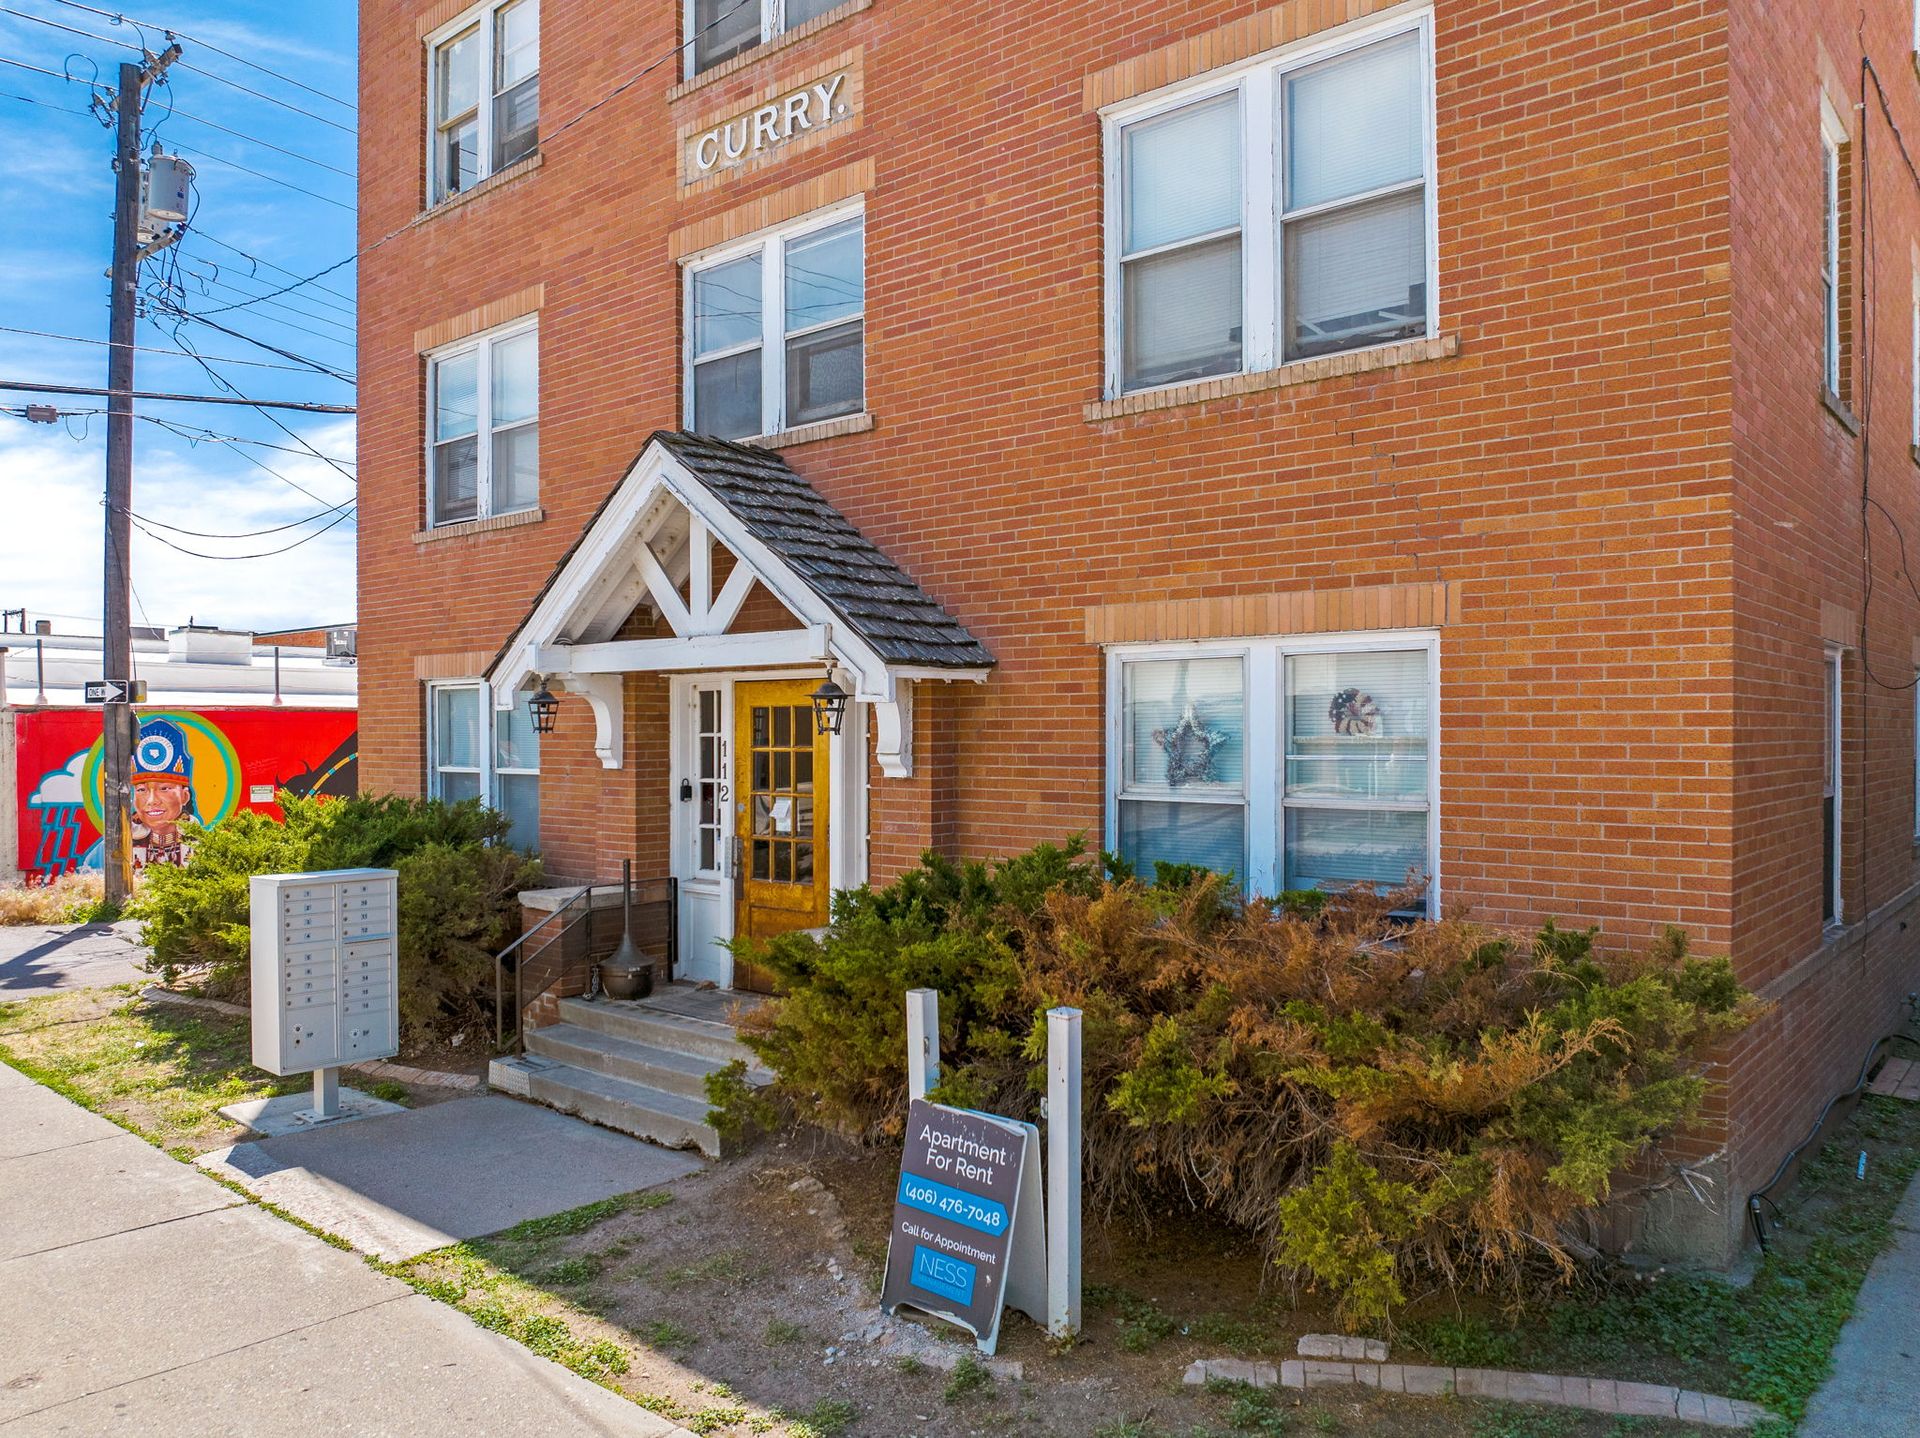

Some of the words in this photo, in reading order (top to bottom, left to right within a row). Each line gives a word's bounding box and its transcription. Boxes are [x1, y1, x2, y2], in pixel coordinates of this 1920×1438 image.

[696, 73, 846, 170] CURRY.
[89, 688, 99, 697] ONE
[720, 740, 729, 802] 112
[920, 1124, 1007, 1166] Apartment
[926, 1148, 952, 1171] For
[955, 1157, 993, 1185] Rent
[906, 1182, 937, 1206] (406)
[939, 1197, 1001, 1226] 476-7048
[901, 1221, 919, 1237] Call
[920, 1226, 934, 1241] for
[934, 1233, 997, 1265] Appointment
[920, 1253, 967, 1288] NESS
